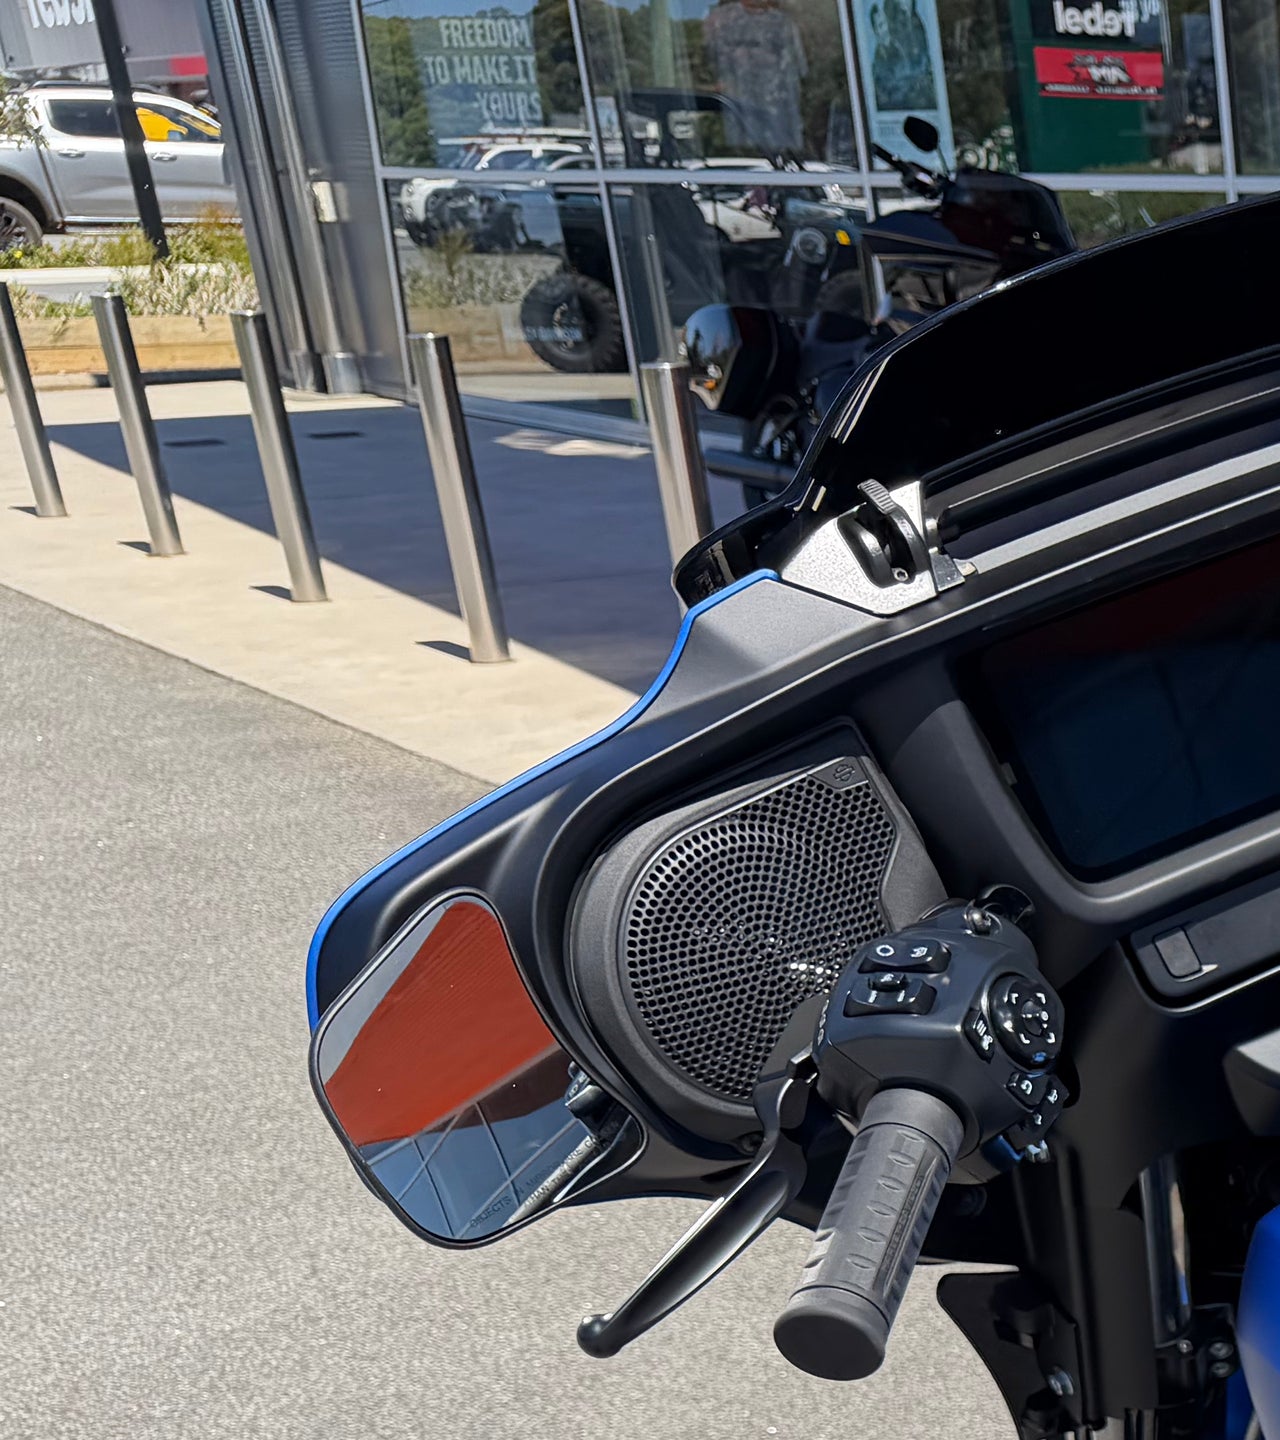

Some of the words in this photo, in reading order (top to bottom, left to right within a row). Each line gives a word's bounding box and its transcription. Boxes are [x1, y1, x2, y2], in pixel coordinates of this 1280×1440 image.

[438, 18, 532, 48] FREEDOM
[422, 55, 450, 85] TO
[452, 55, 513, 84] MAKE
[512, 55, 538, 83] IT
[476, 91, 543, 122] YOURS
[469, 1195, 511, 1228] OBJECTS
